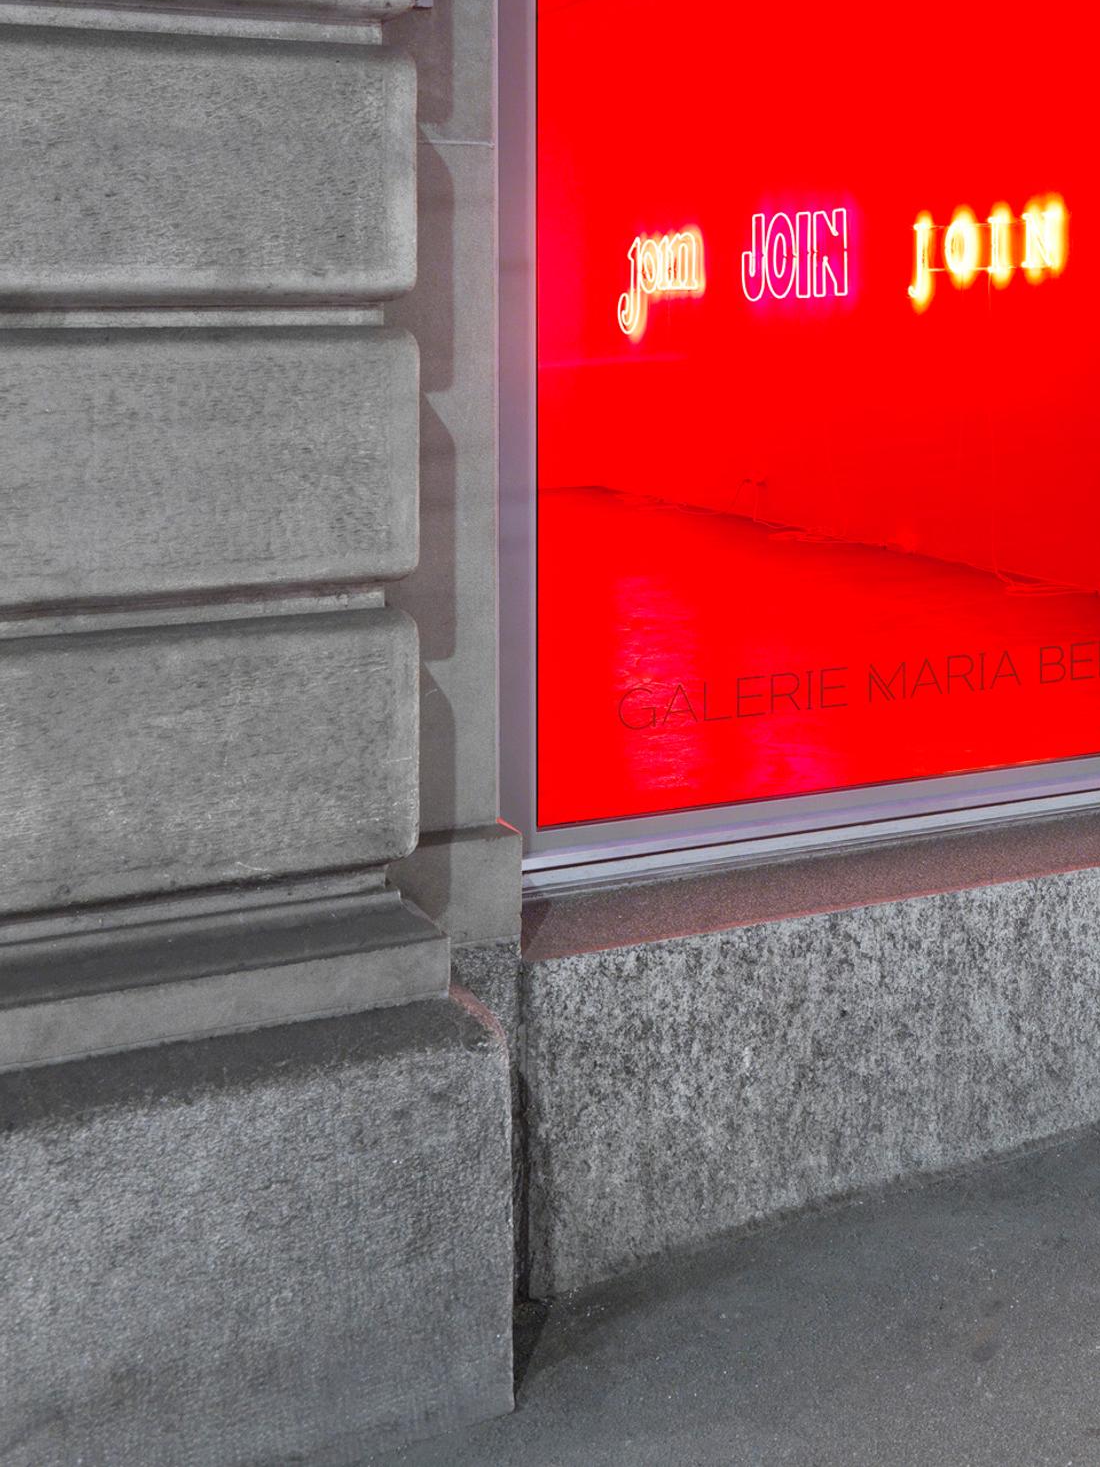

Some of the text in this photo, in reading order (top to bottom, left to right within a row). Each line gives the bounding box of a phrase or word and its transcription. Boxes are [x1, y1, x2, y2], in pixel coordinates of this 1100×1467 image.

[742, 207, 849, 302] JOIN
[618, 666, 849, 731] GALERIE
[867, 649, 1022, 703] MARIA
